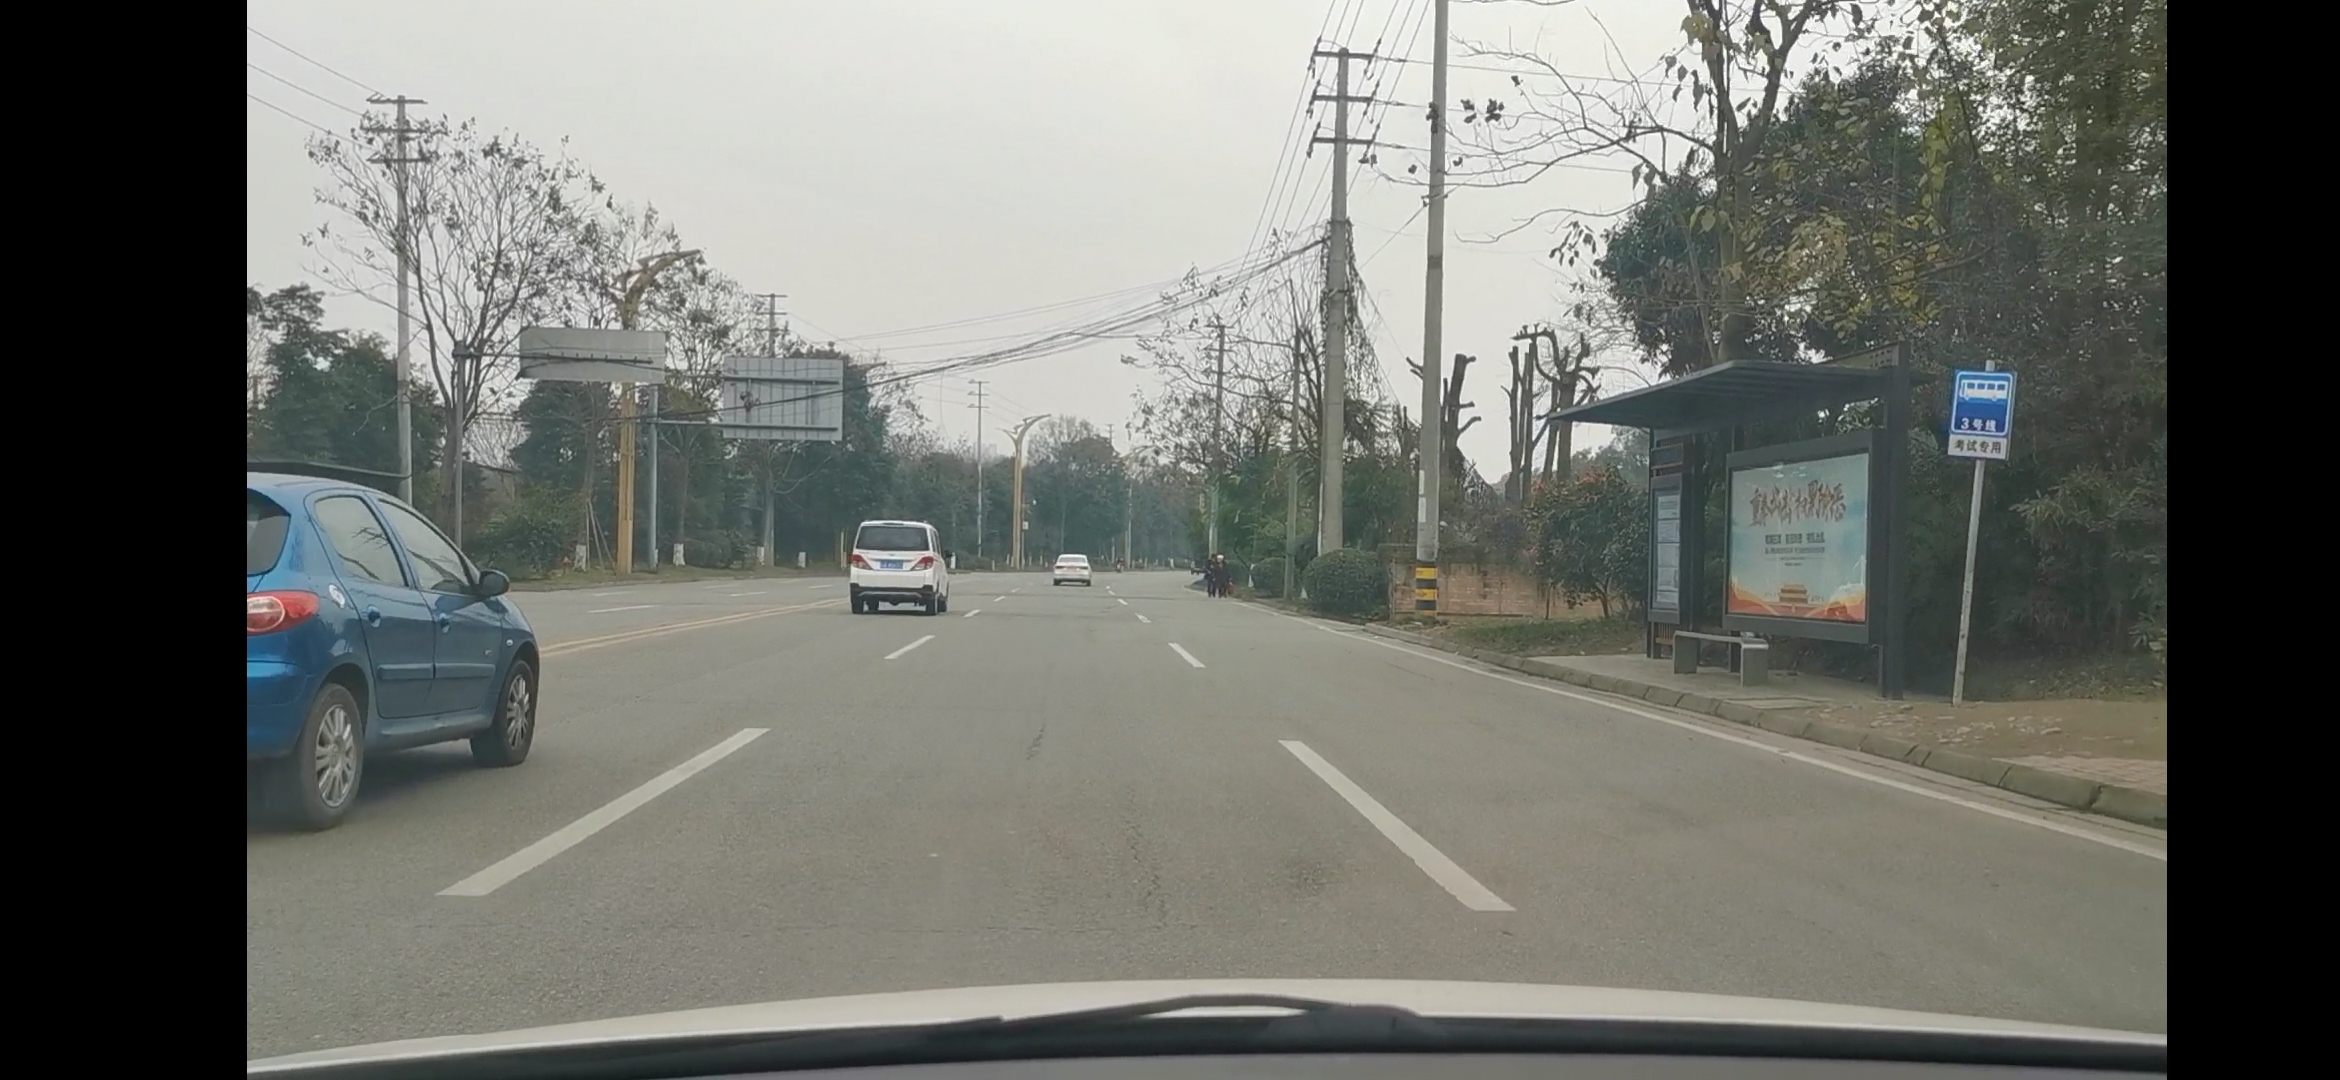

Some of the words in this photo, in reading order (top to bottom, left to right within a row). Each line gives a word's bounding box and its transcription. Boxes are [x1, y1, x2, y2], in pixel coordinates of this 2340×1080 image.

[1960, 417, 1997, 432] 3号线
[1954, 439, 2001, 454] 考试专用
